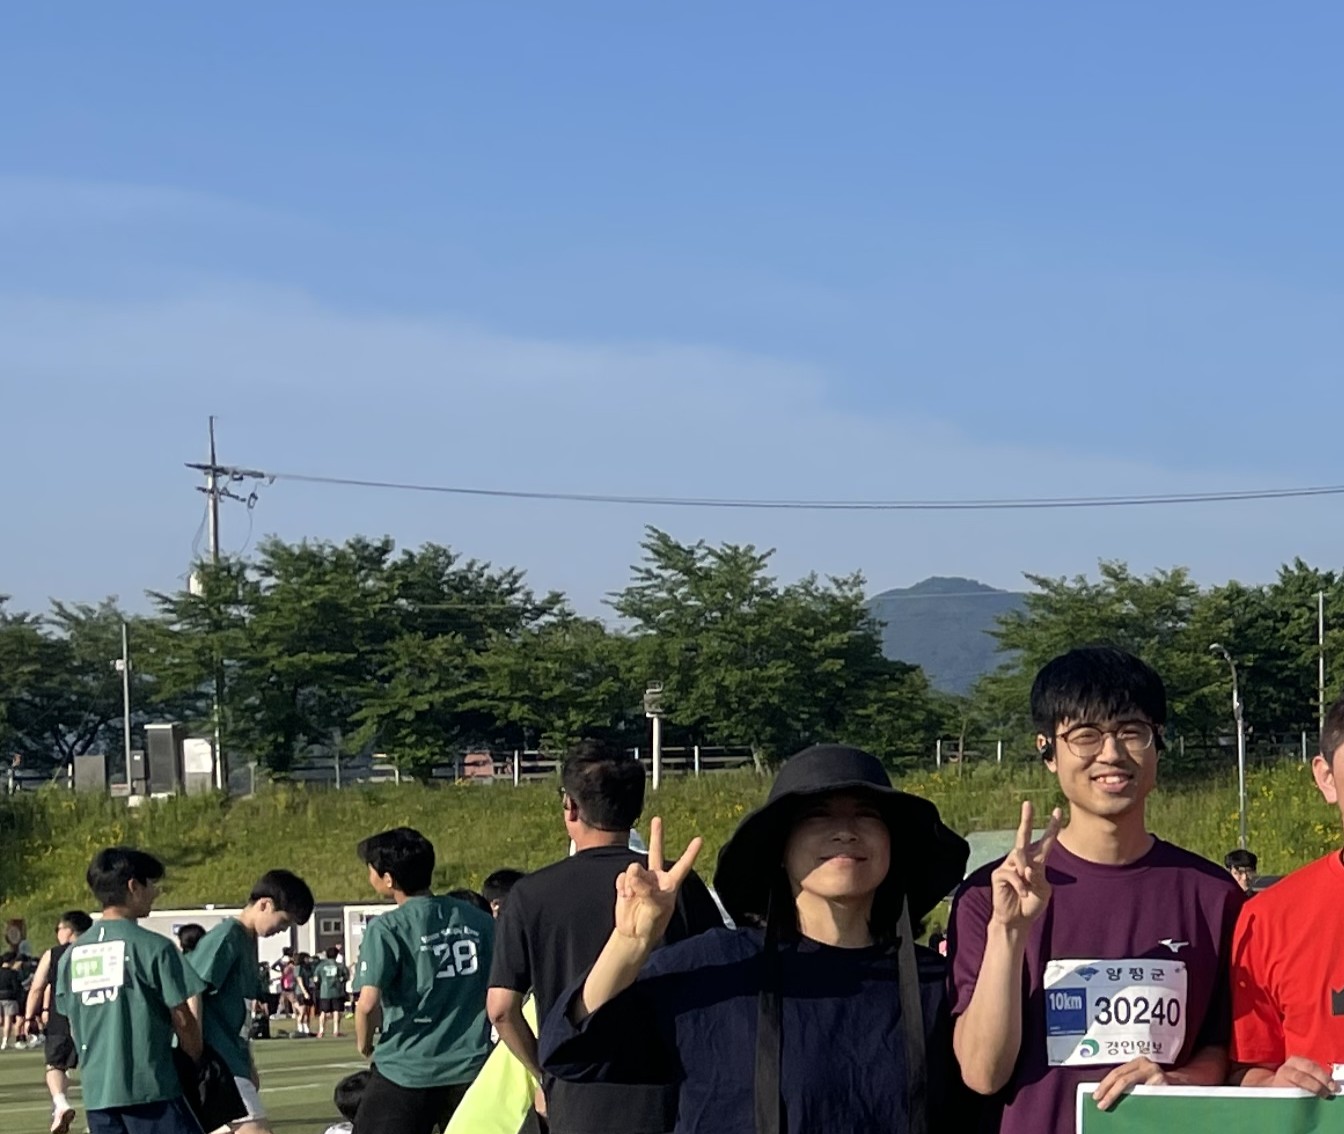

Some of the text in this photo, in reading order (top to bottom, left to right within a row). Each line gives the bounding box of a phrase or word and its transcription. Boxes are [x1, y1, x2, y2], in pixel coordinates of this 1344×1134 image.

[432, 939, 478, 978] 28
[1106, 967, 1165, 981] 양평군
[1050, 992, 1082, 1011] 10km
[1094, 996, 1181, 1027] 30240
[1105, 1040, 1164, 1056] 경인일보
